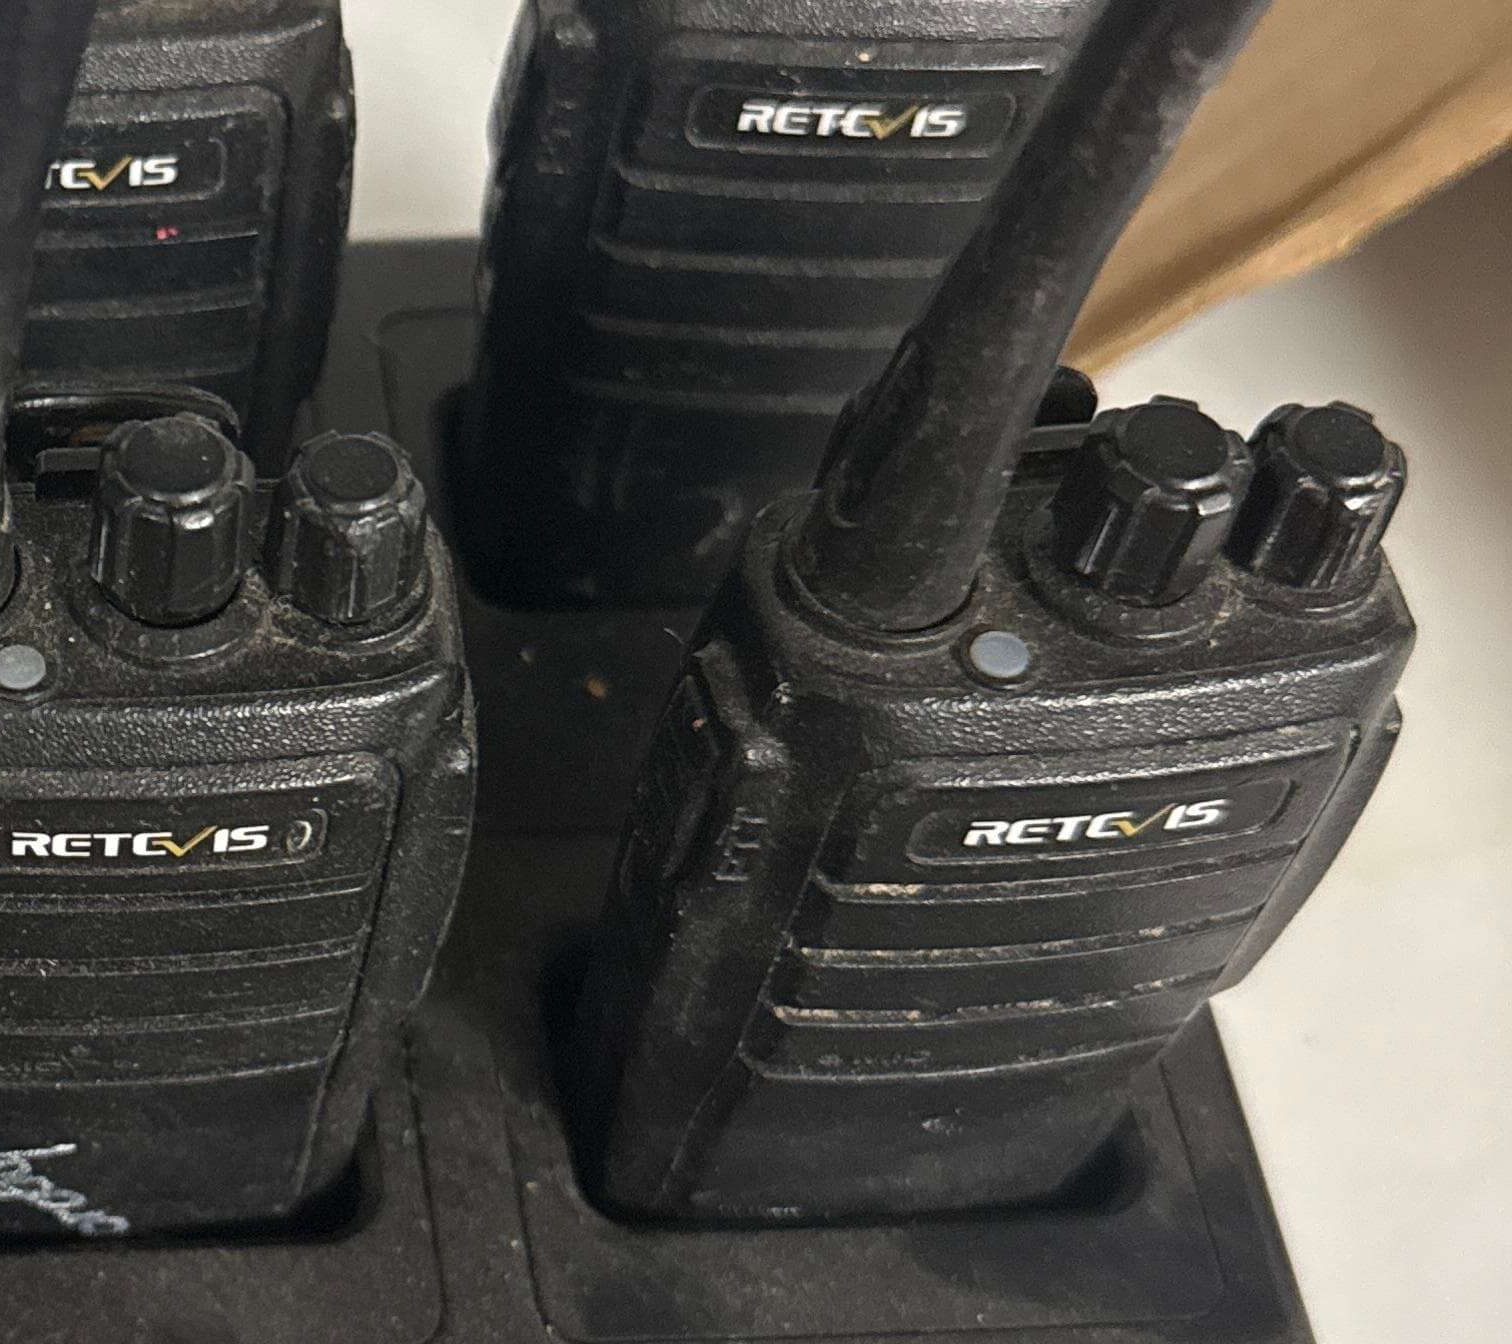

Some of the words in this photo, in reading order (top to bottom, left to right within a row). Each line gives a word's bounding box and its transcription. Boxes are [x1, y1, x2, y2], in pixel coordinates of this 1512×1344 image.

[738, 101, 965, 140] RETEVIS
[44, 155, 178, 191] EVIS
[11, 824, 271, 857] RETEVIS
[963, 799, 1230, 847] RETEVIS
